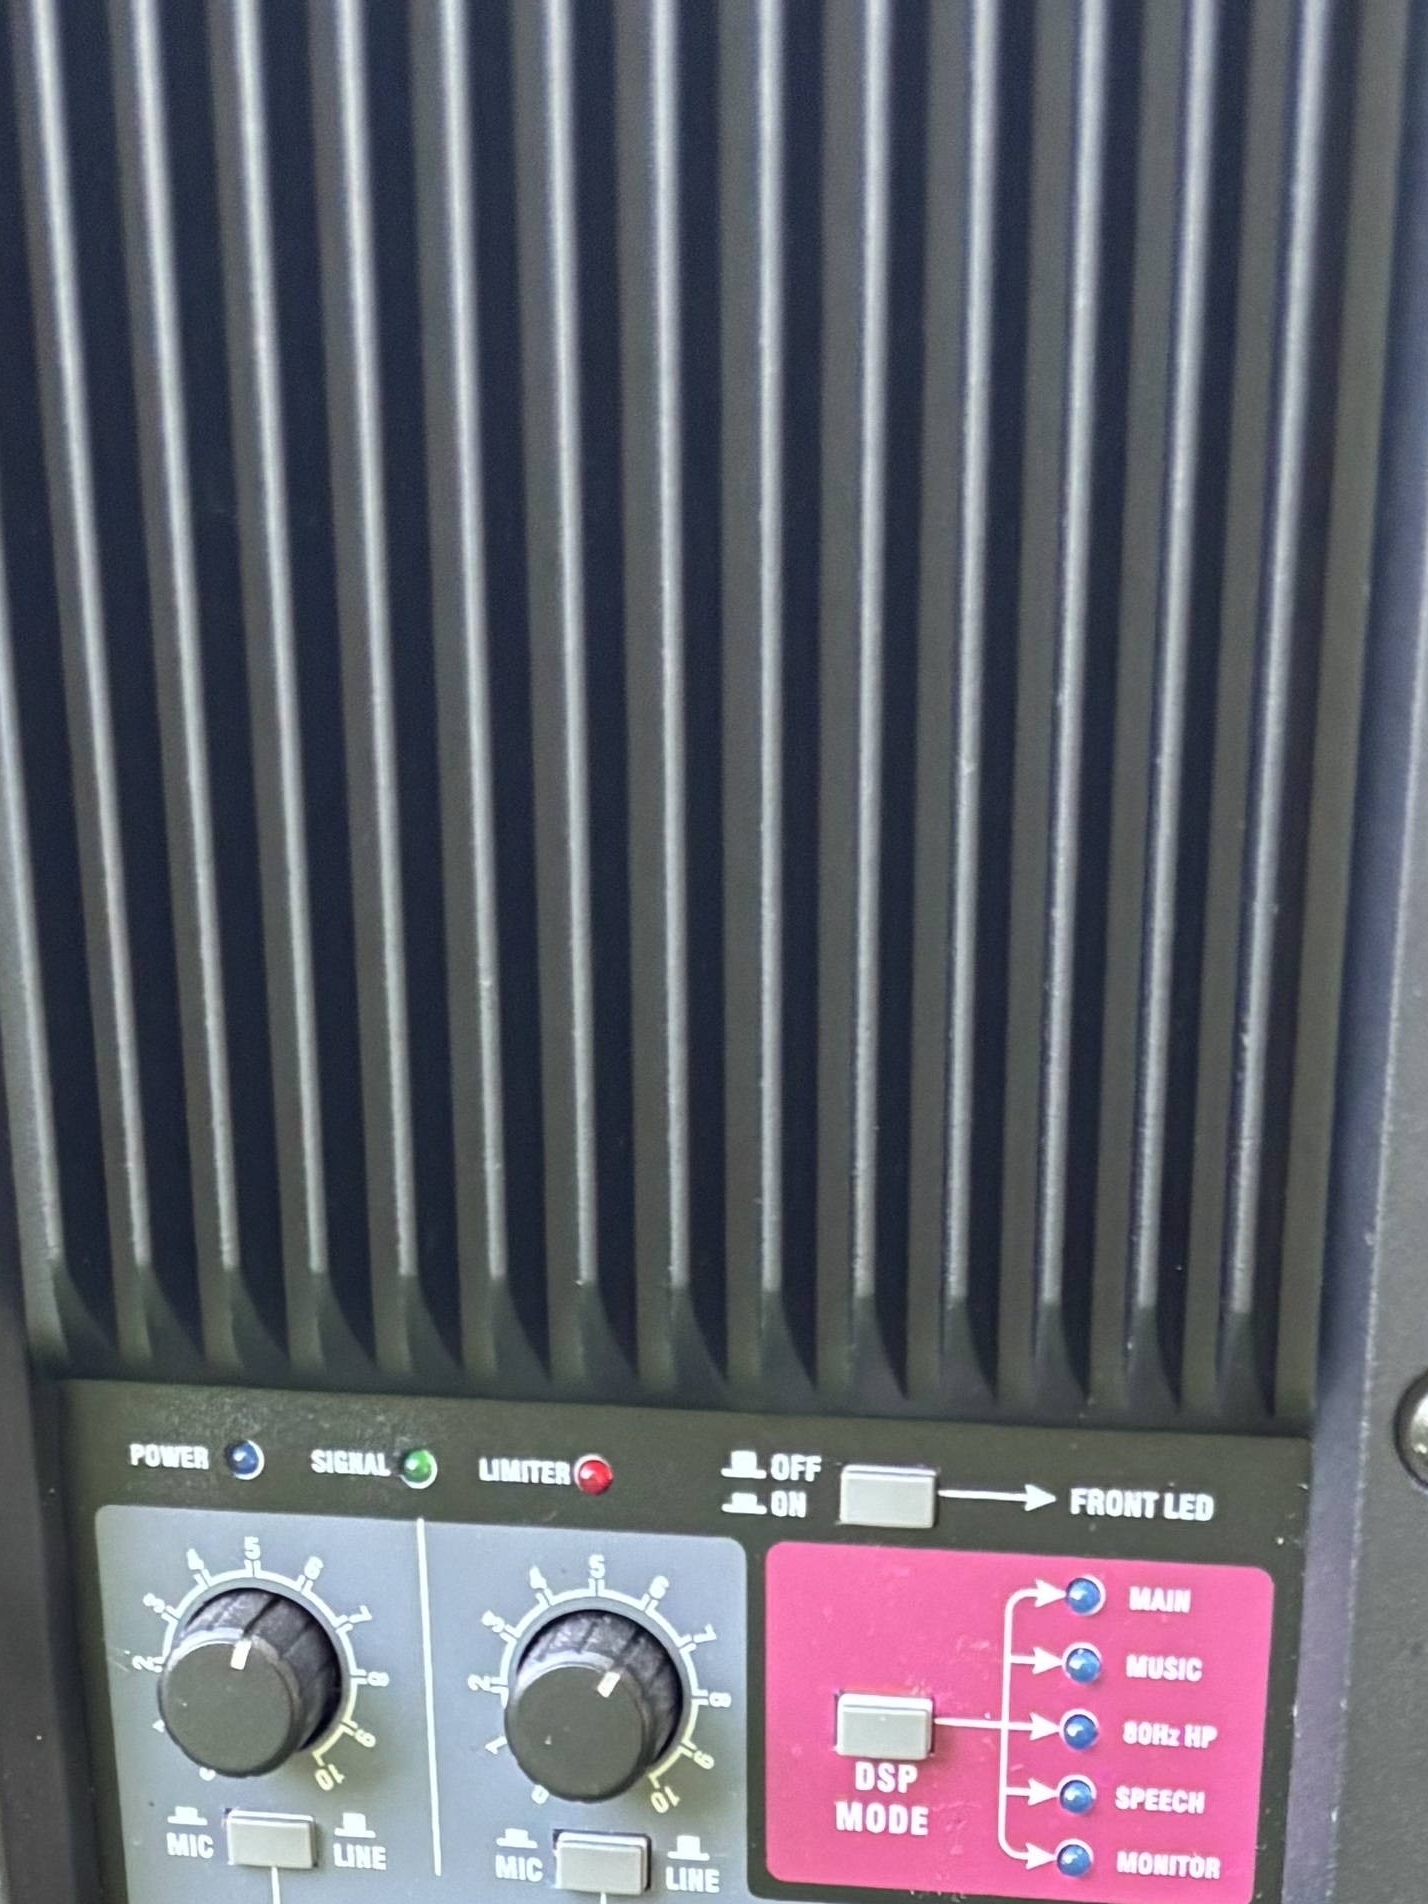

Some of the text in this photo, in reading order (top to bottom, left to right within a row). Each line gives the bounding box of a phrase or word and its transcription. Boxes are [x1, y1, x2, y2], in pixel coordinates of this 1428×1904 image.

[130, 1443, 209, 1470] POWER
[311, 1449, 391, 1477] SIGNAL
[771, 1453, 821, 1482] OFF
[479, 1457, 571, 1485] LIMITER
[771, 1491, 807, 1518] ON
[1070, 1487, 1214, 1522] FRONT LED
[244, 1537, 260, 1557] 5
[588, 1555, 605, 1578] 5
[1130, 1586, 1192, 1614] MAIN
[1127, 1655, 1203, 1683] MUSIC
[1184, 1723, 1218, 1749] HP
[854, 1762, 918, 1794] DSP
[1114, 1788, 1205, 1815] SPEECH
[835, 1802, 928, 1836] MODE
[166, 1832, 214, 1859] MIC
[333, 1843, 387, 1870] LINE
[495, 1855, 543, 1882] MIC
[1116, 1851, 1221, 1879] MONITOR
[665, 1866, 720, 1893] LINE
